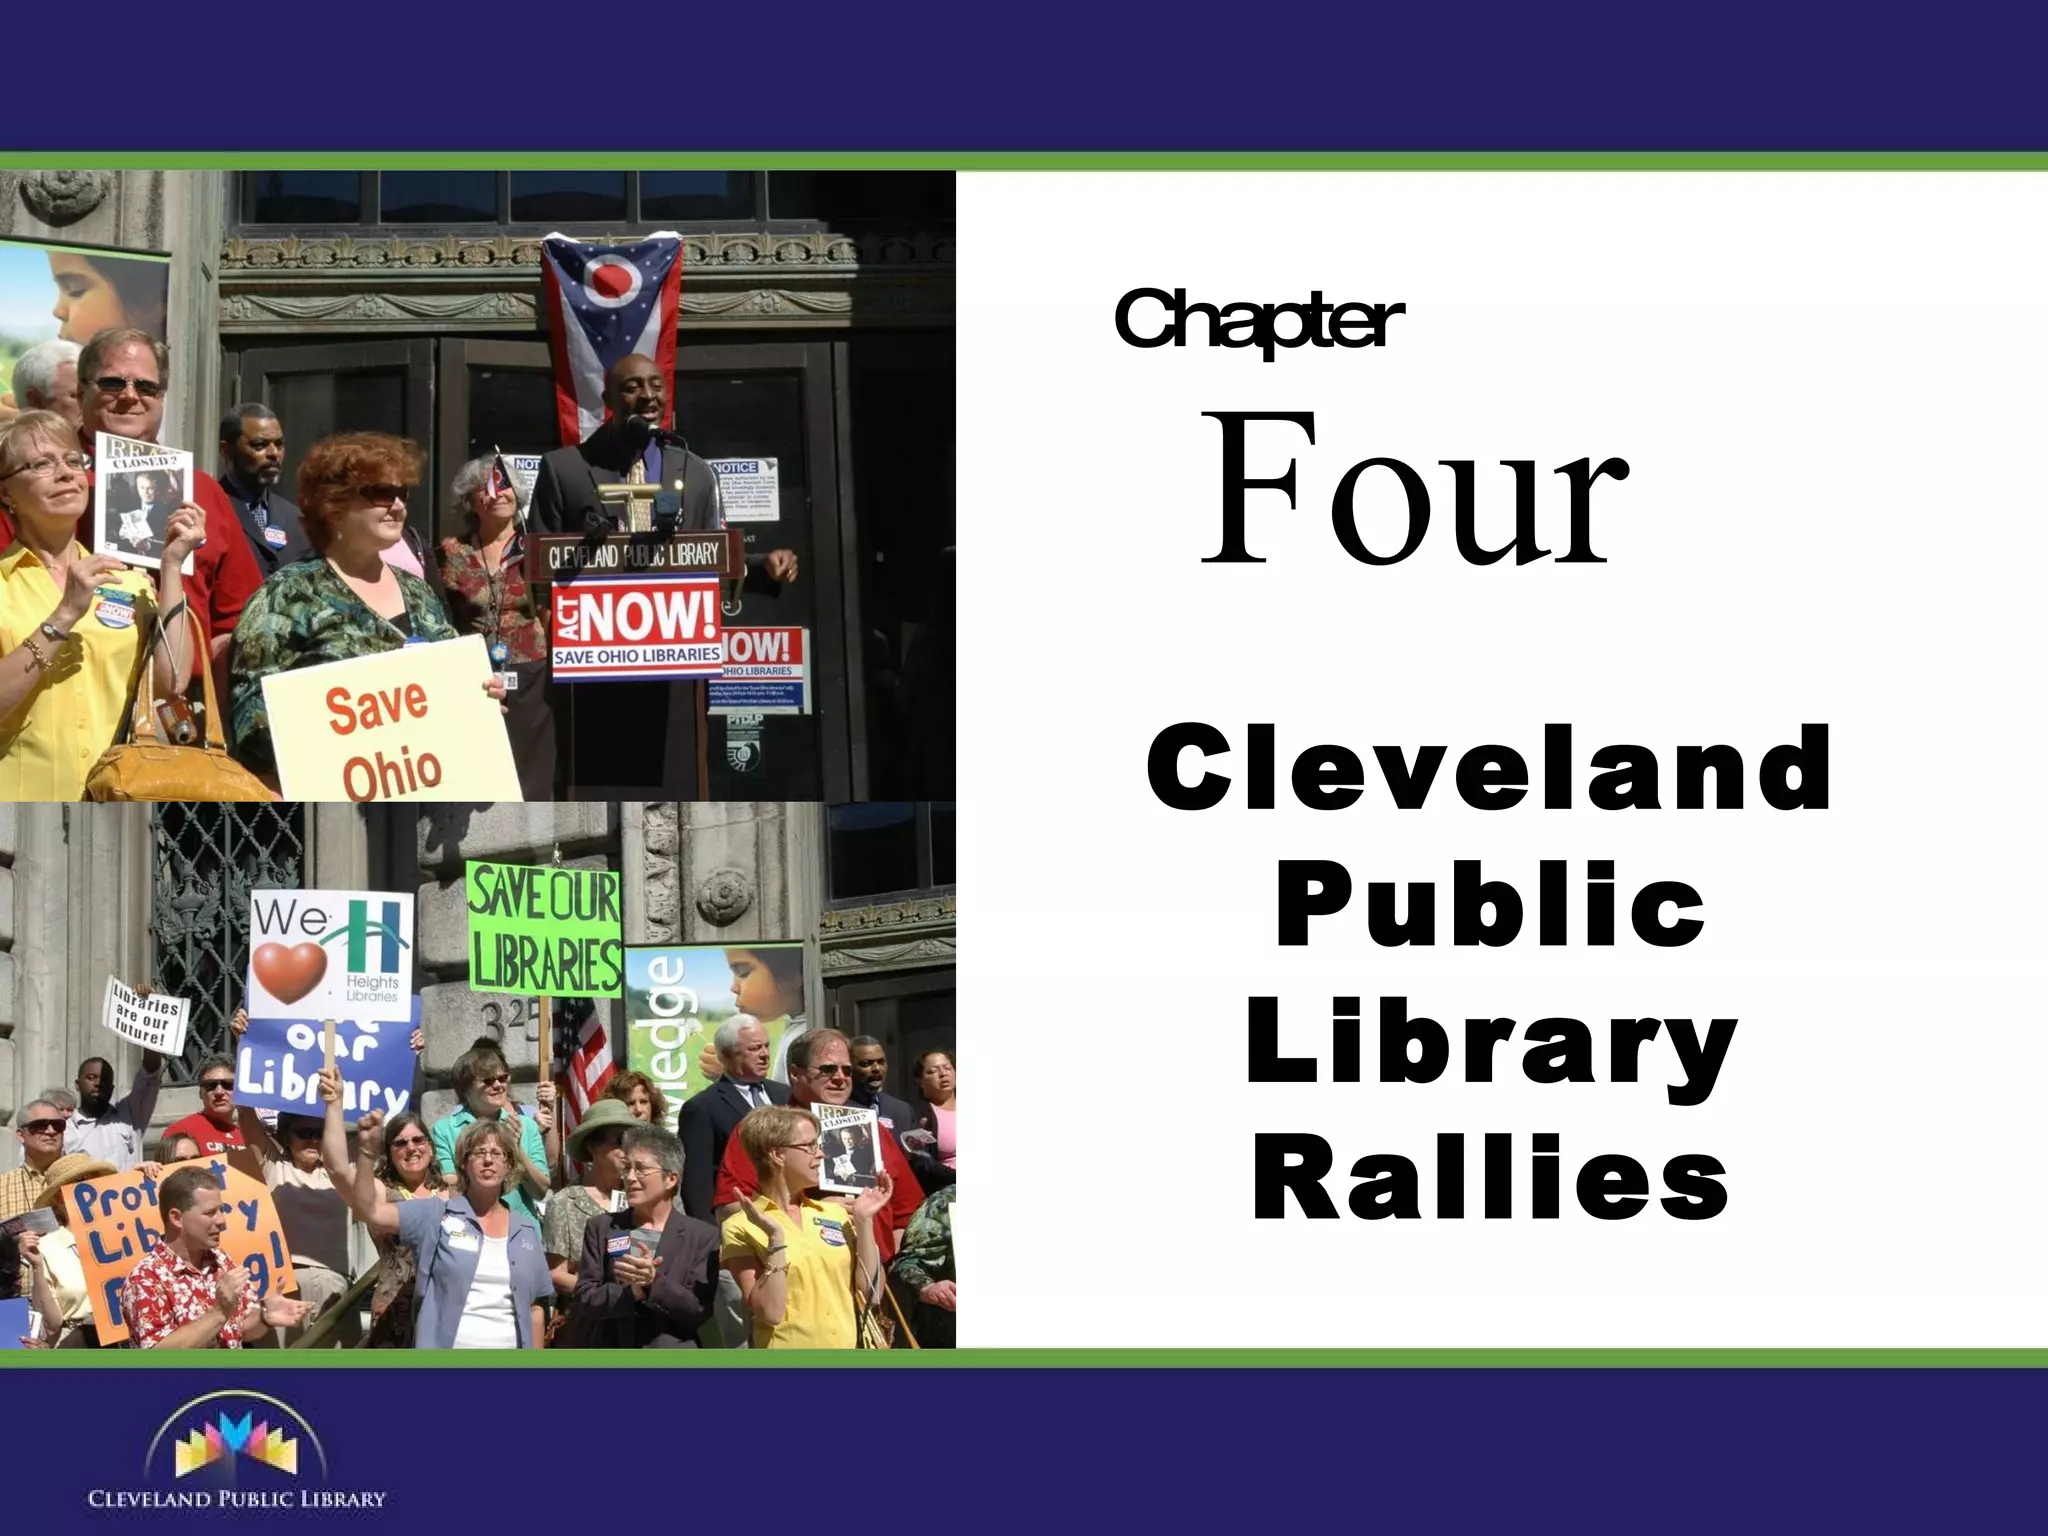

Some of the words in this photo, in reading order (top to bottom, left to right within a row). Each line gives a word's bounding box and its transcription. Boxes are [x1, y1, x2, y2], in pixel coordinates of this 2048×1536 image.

[516, 459, 540, 470] NOT
[712, 462, 757, 473] NOTICE
[550, 545, 619, 570] CLEVELAND
[624, 545, 665, 568] PUBLIC
[669, 542, 719, 567] LIBRARY
[557, 595, 580, 642] ACT
[579, 590, 717, 643] NOW!
[554, 650, 594, 665] SAVE
[598, 649, 639, 664] OHIO
[643, 647, 721, 663] LIBRARIES
[745, 666, 793, 676] LIBRARIES
[326, 683, 429, 736] Save
[343, 745, 443, 802] Ohio
[468, 864, 546, 920] SAVE
[551, 870, 620, 923] OUR
[253, 898, 328, 936] We
[474, 930, 622, 992] LIBRARIES
[113, 983, 179, 1017] Libraries
[347, 975, 399, 991] Heights
[347, 990, 398, 1003] Libraries
[115, 1017, 165, 1047] future!
[117, 1003, 138, 1023] are
[143, 1015, 169, 1031] our
[286, 1023, 379, 1062] our
[74, 1159, 227, 1224] Prott
[89, 1199, 259, 1265] Liby
